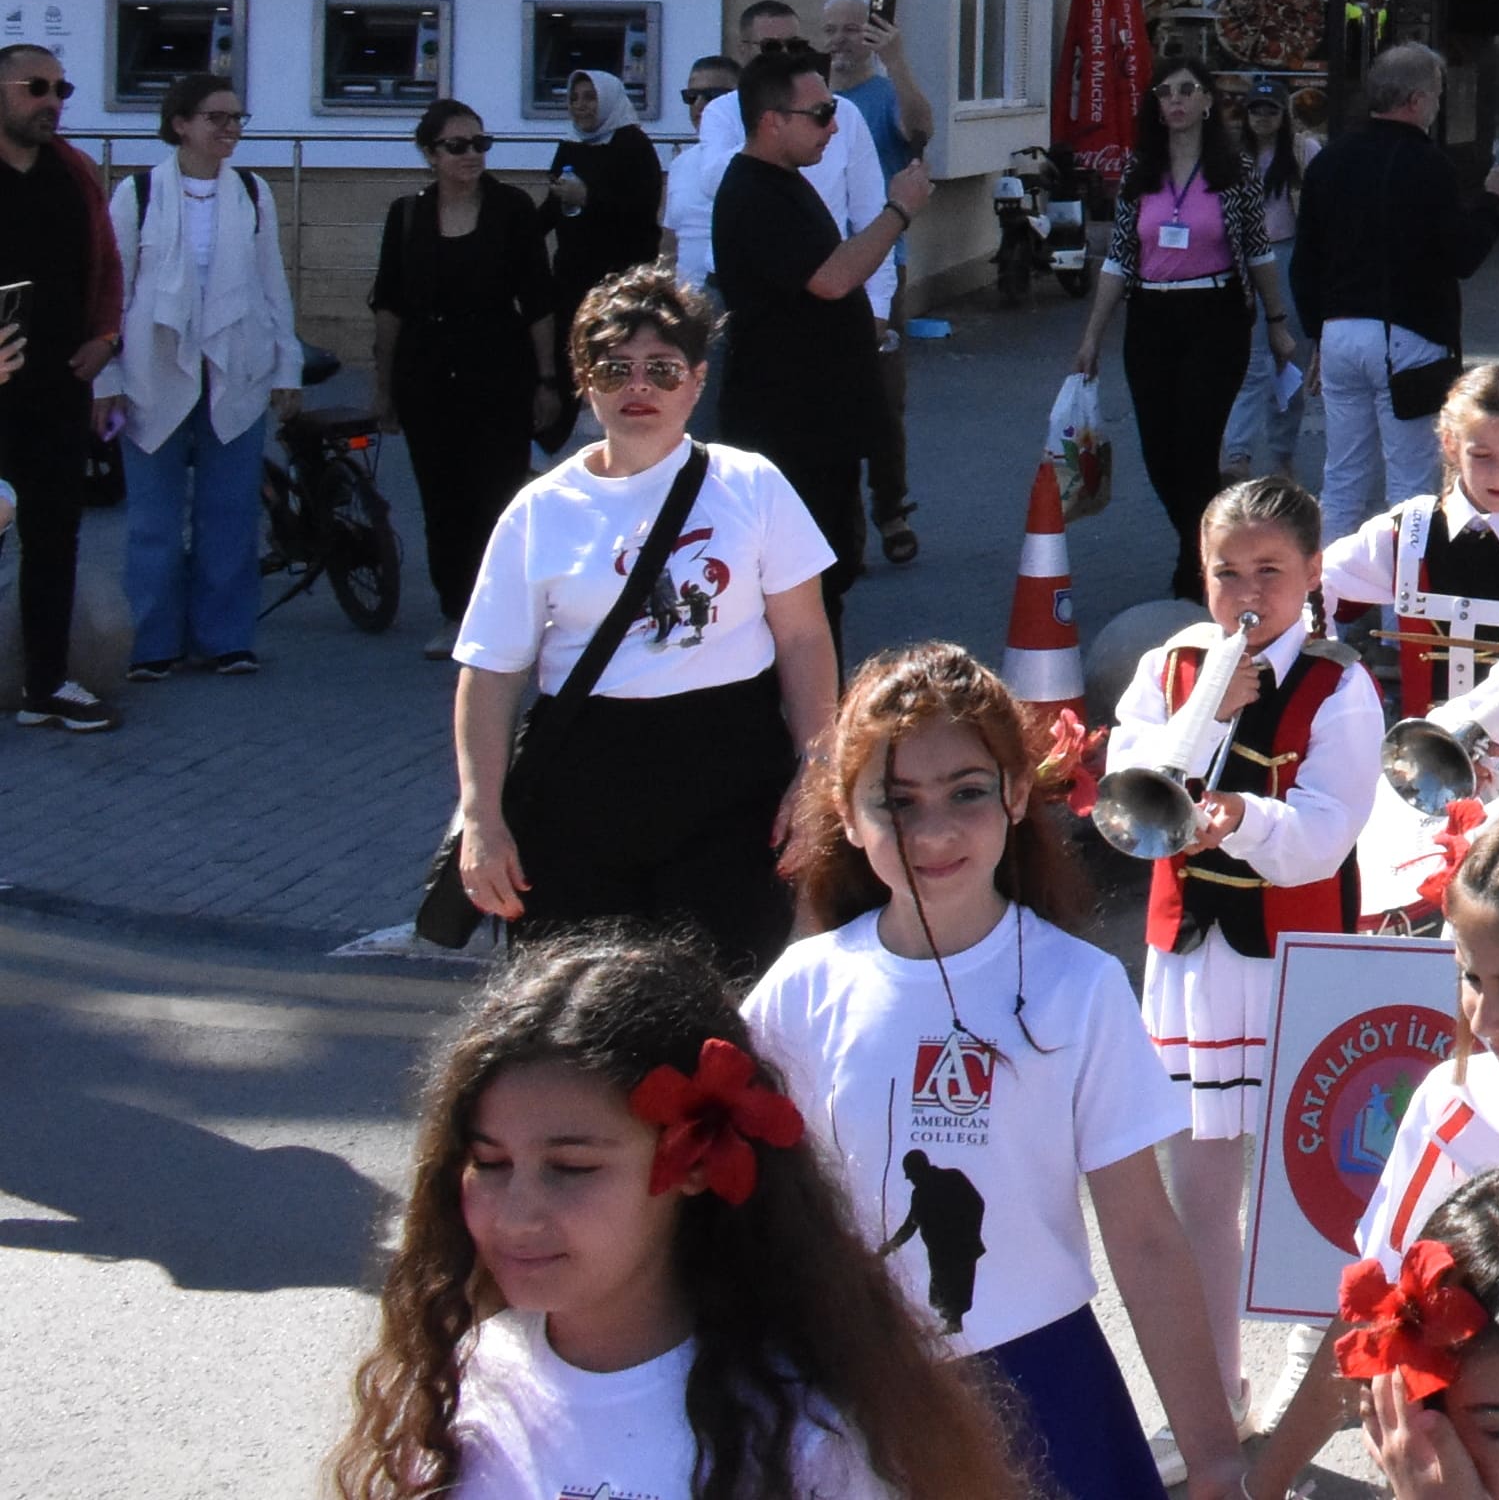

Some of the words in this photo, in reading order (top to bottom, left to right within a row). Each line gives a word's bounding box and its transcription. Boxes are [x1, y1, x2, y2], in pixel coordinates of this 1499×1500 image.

[1091, 60, 1105, 123] Mucize
[1297, 1019, 1399, 1155] ÇATALKÖY
[910, 1130, 989, 1146] COLLEGE
[911, 1115, 990, 1129] AMERICAN
